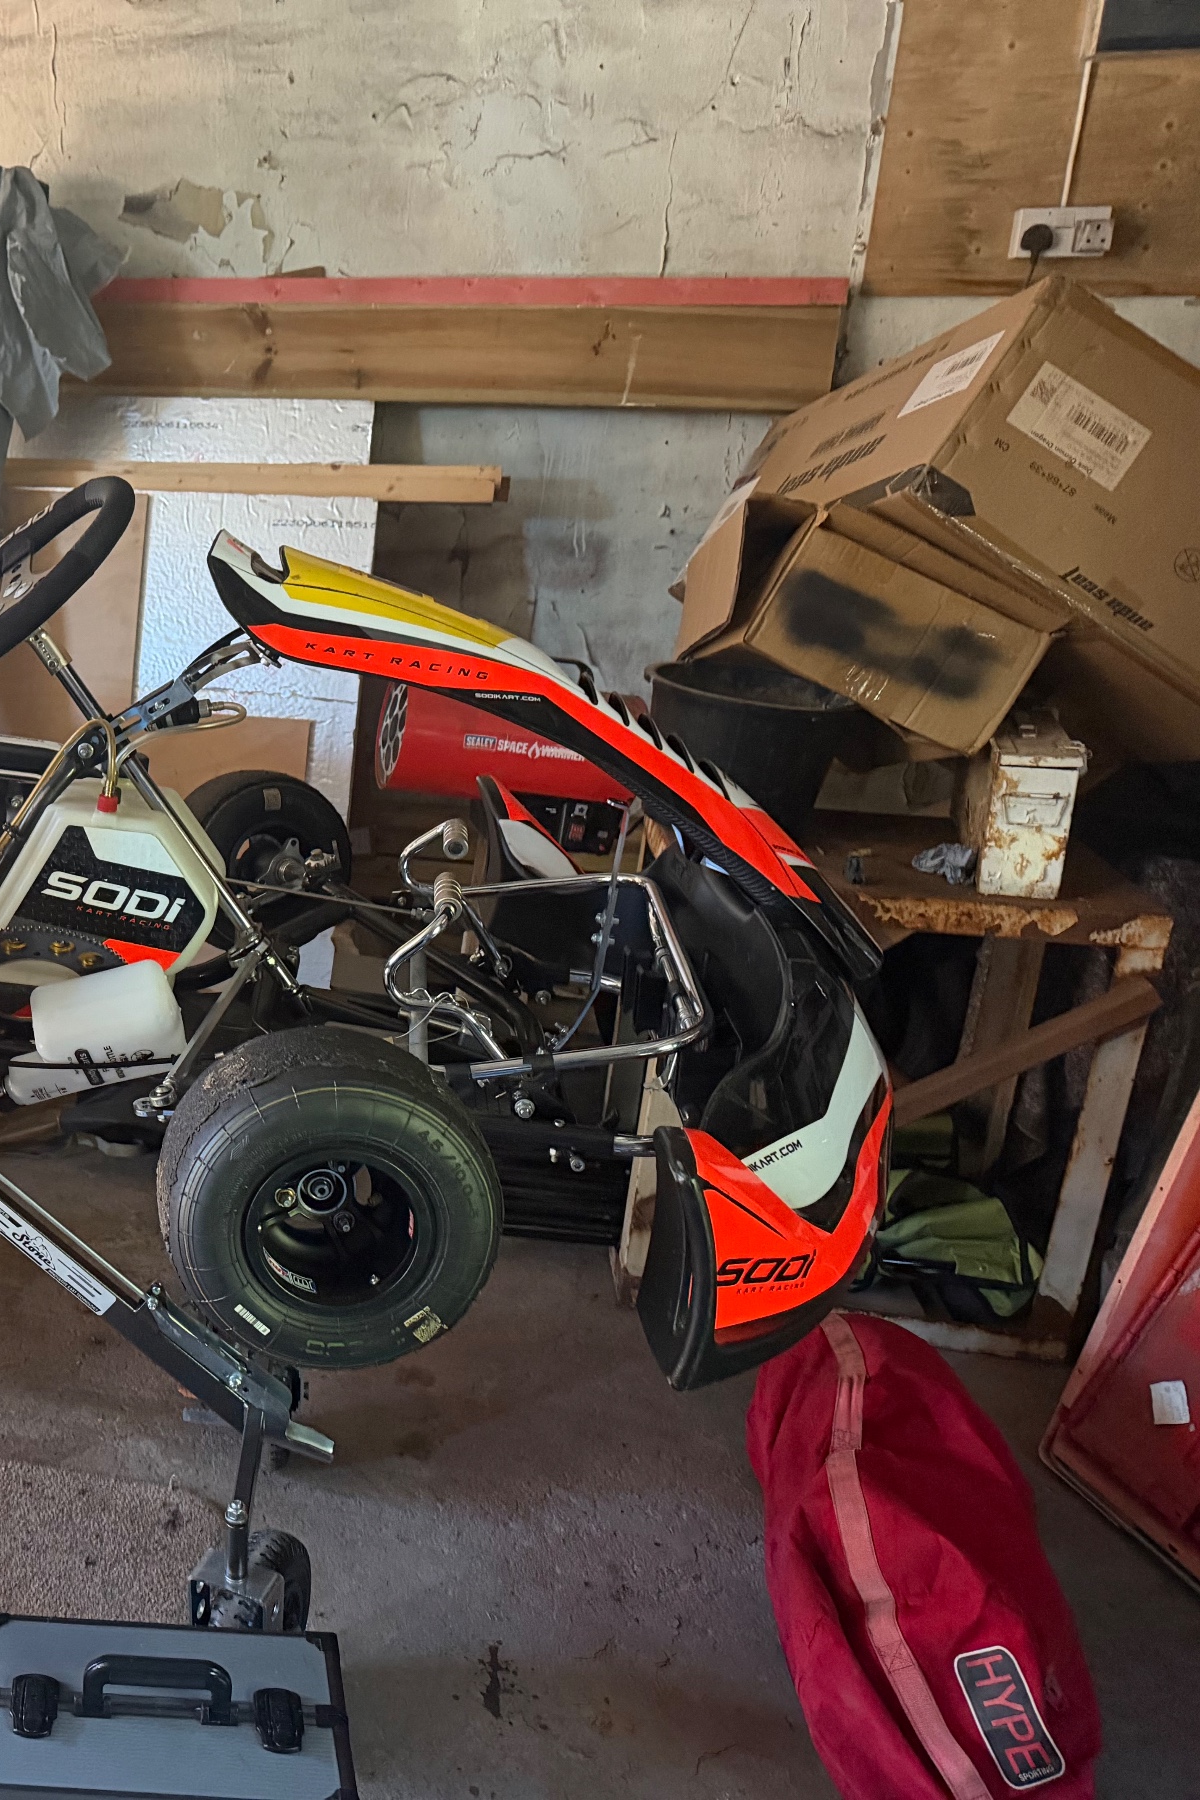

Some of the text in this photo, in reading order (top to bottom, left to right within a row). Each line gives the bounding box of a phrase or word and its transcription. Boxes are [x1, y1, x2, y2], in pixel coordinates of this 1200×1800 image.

[994, 437, 1011, 452] CM
[304, 642, 490, 680] KART RACING
[474, 692, 541, 702] SODIKART.COM
[466, 736, 495, 749] SEALEY
[497, 739, 528, 754] SPACE
[76, 905, 172, 931] KART RACING
[11, 1232, 52, 1266] Stone
[736, 1281, 806, 1295] KART RACING
[965, 1654, 1051, 1775] HYPE
[1018, 1763, 1055, 1782] SPORTING
